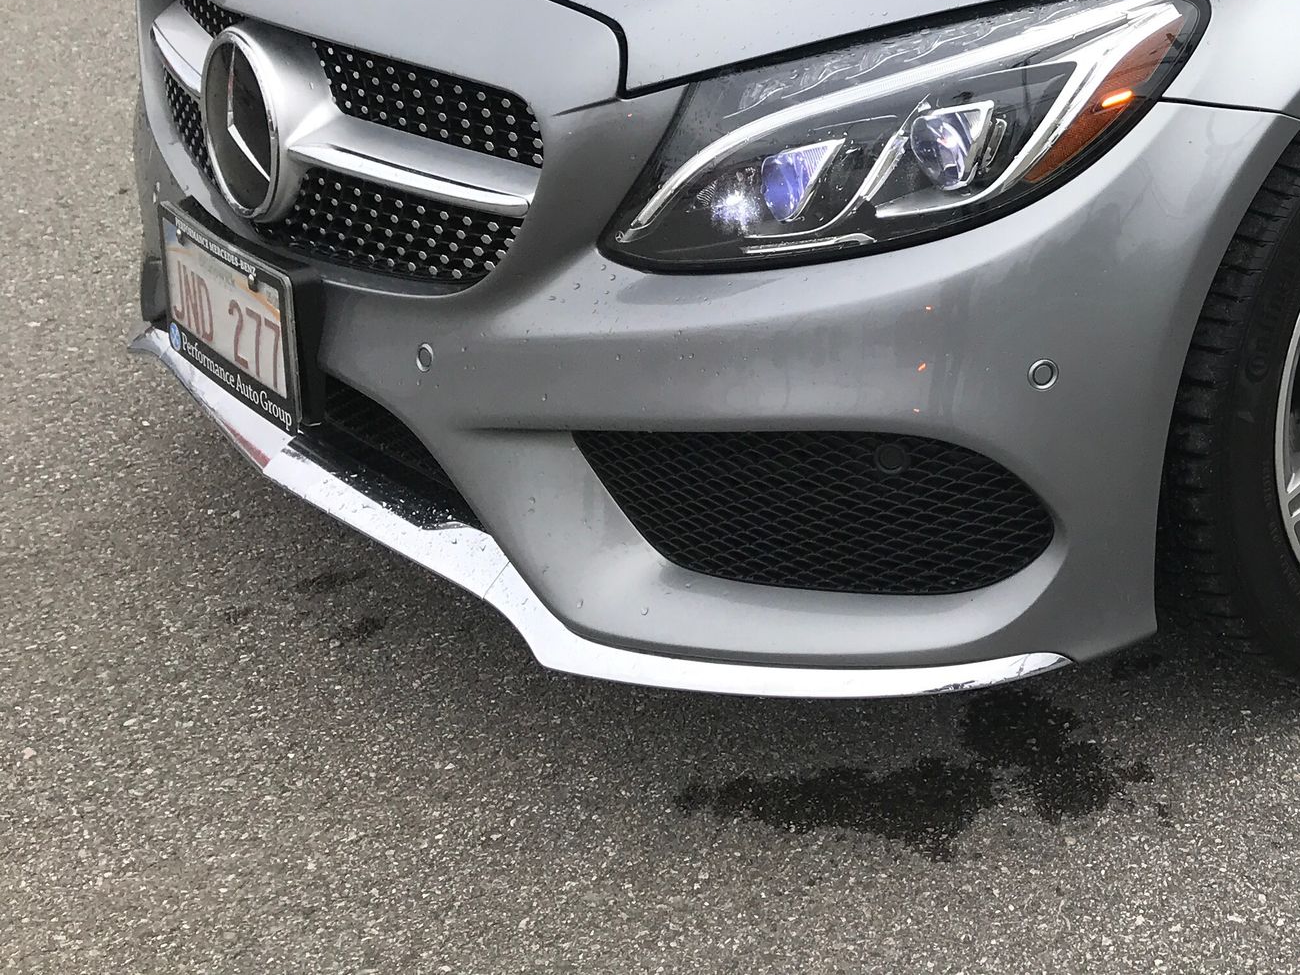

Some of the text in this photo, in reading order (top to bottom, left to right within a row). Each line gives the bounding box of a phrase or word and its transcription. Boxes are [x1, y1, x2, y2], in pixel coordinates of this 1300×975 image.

[173, 260, 280, 389] JND 277
[181, 332, 292, 431] Performance Auto Group
